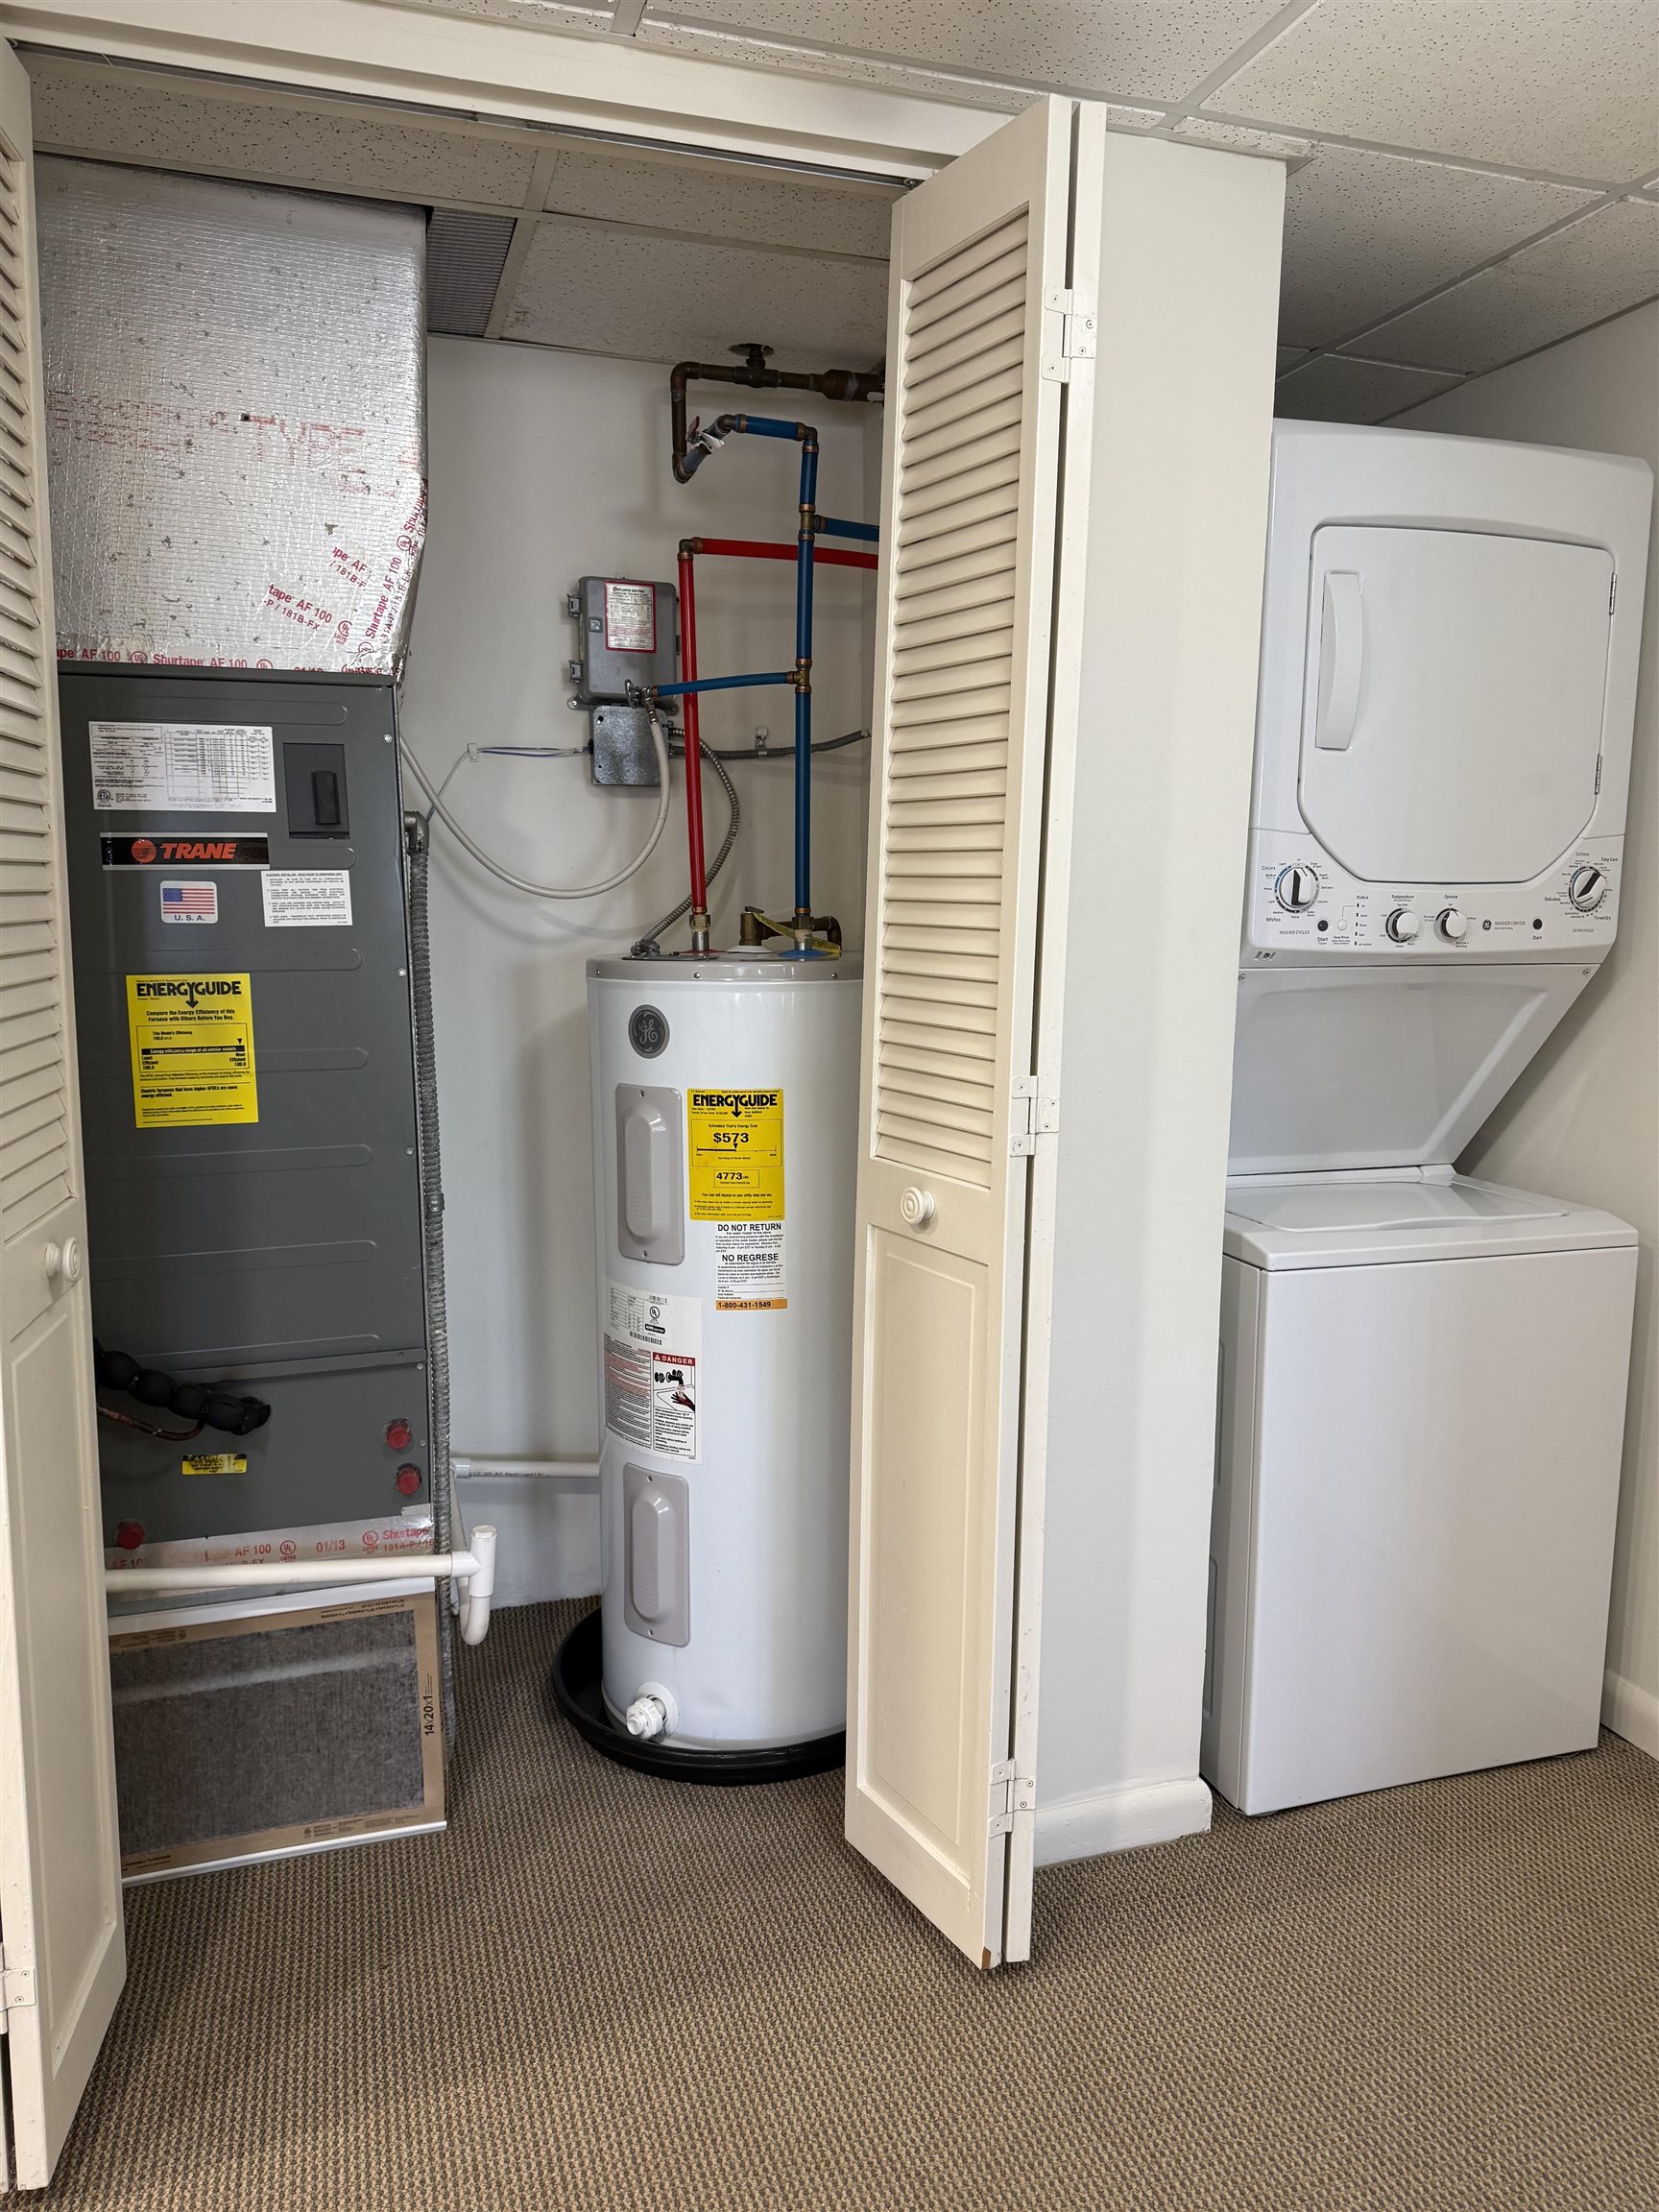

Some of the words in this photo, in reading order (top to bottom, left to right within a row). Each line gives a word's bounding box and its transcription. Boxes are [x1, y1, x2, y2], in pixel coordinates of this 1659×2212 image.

[350, 560, 368, 573] AF
[388, 557, 402, 574] 100
[383, 574, 395, 592] AF
[296, 599, 313, 612] AF
[314, 608, 332, 623] 100
[365, 595, 389, 639] Shurtape
[282, 607, 320, 631] 181B-FX
[81, 649, 96, 659] AF
[102, 651, 121, 661] 100
[153, 654, 203, 666] Shurtape
[229, 659, 247, 668] 100
[161, 843, 237, 859] TRANE
[136, 980, 242, 998] ENERGYGUIDE
[693, 1094, 778, 1107] ENERGYGUIDE
[713, 1132, 749, 1143] $573
[749, 1222, 781, 1231] RETURN
[736, 1253, 779, 1262] REGRESE
[661, 1355, 693, 1365] DANGER
[234, 1546, 250, 1556] AF
[253, 1544, 272, 1554] 100
[316, 1539, 346, 1552] 01/13
